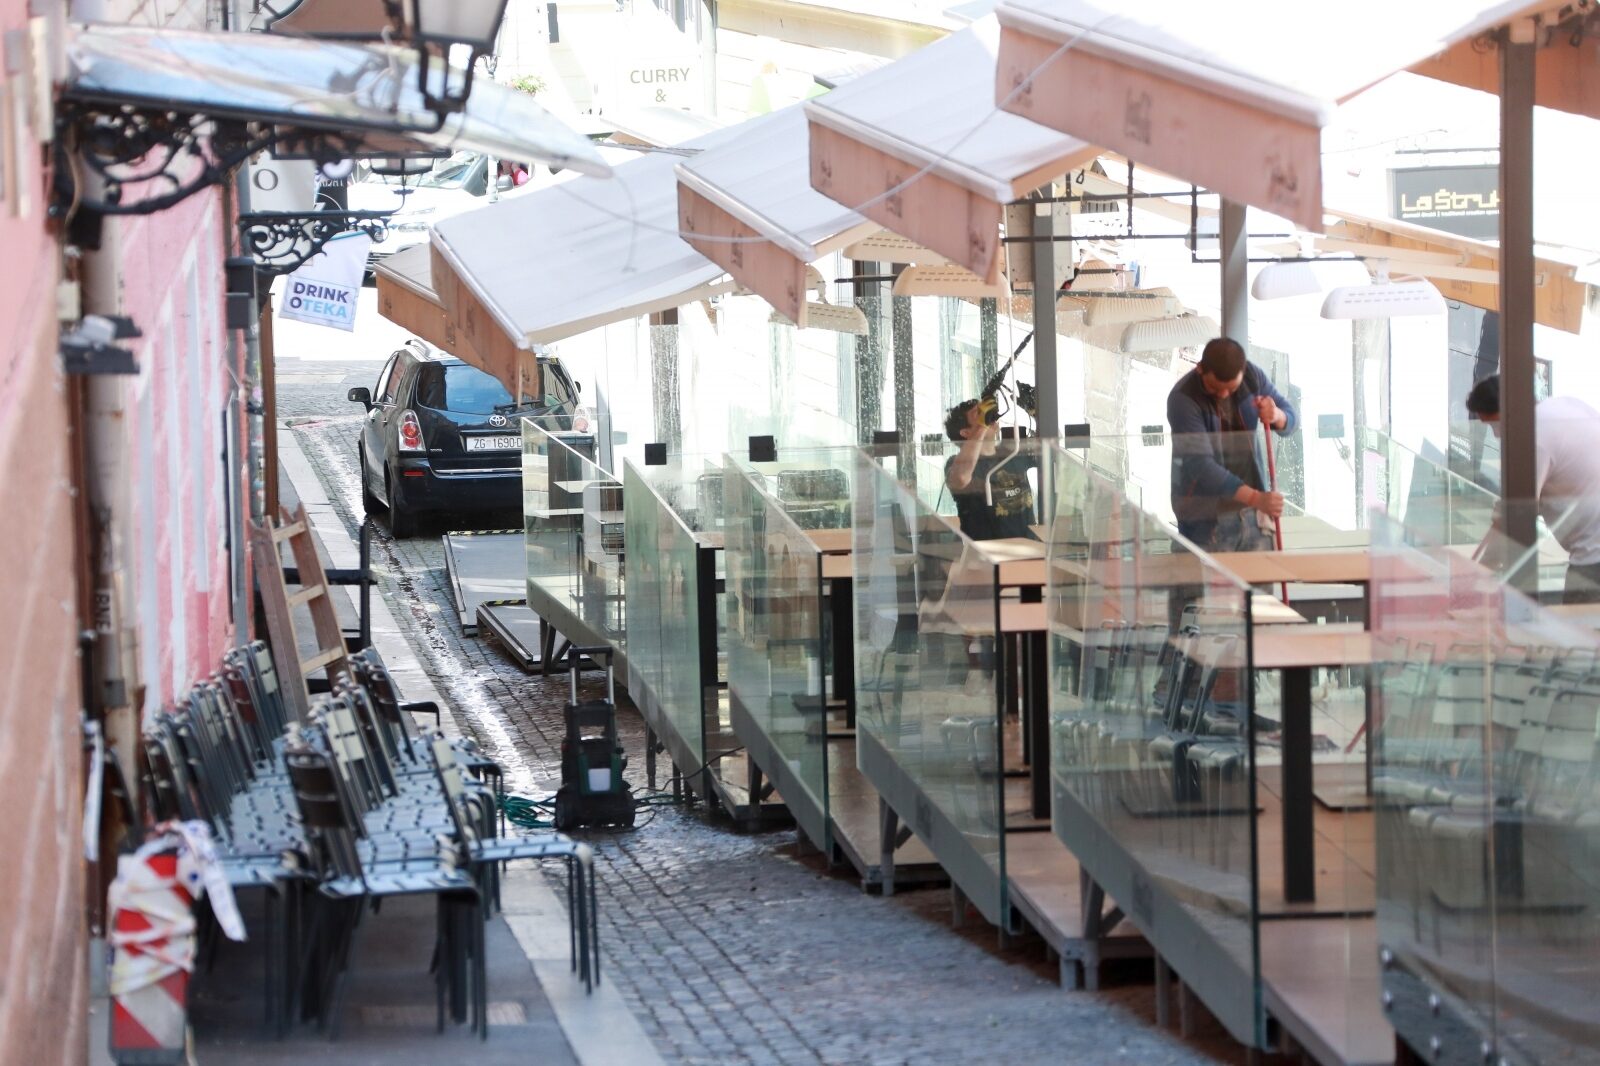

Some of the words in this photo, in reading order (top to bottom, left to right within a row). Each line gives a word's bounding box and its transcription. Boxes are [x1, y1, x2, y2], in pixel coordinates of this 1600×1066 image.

[630, 67, 690, 84] CURRY
[655, 88, 667, 103] &
[1402, 193, 1432, 211] La
[293, 281, 350, 304] DRINK
[289, 296, 348, 319] OTEKA
[474, 438, 486, 449] ZG
